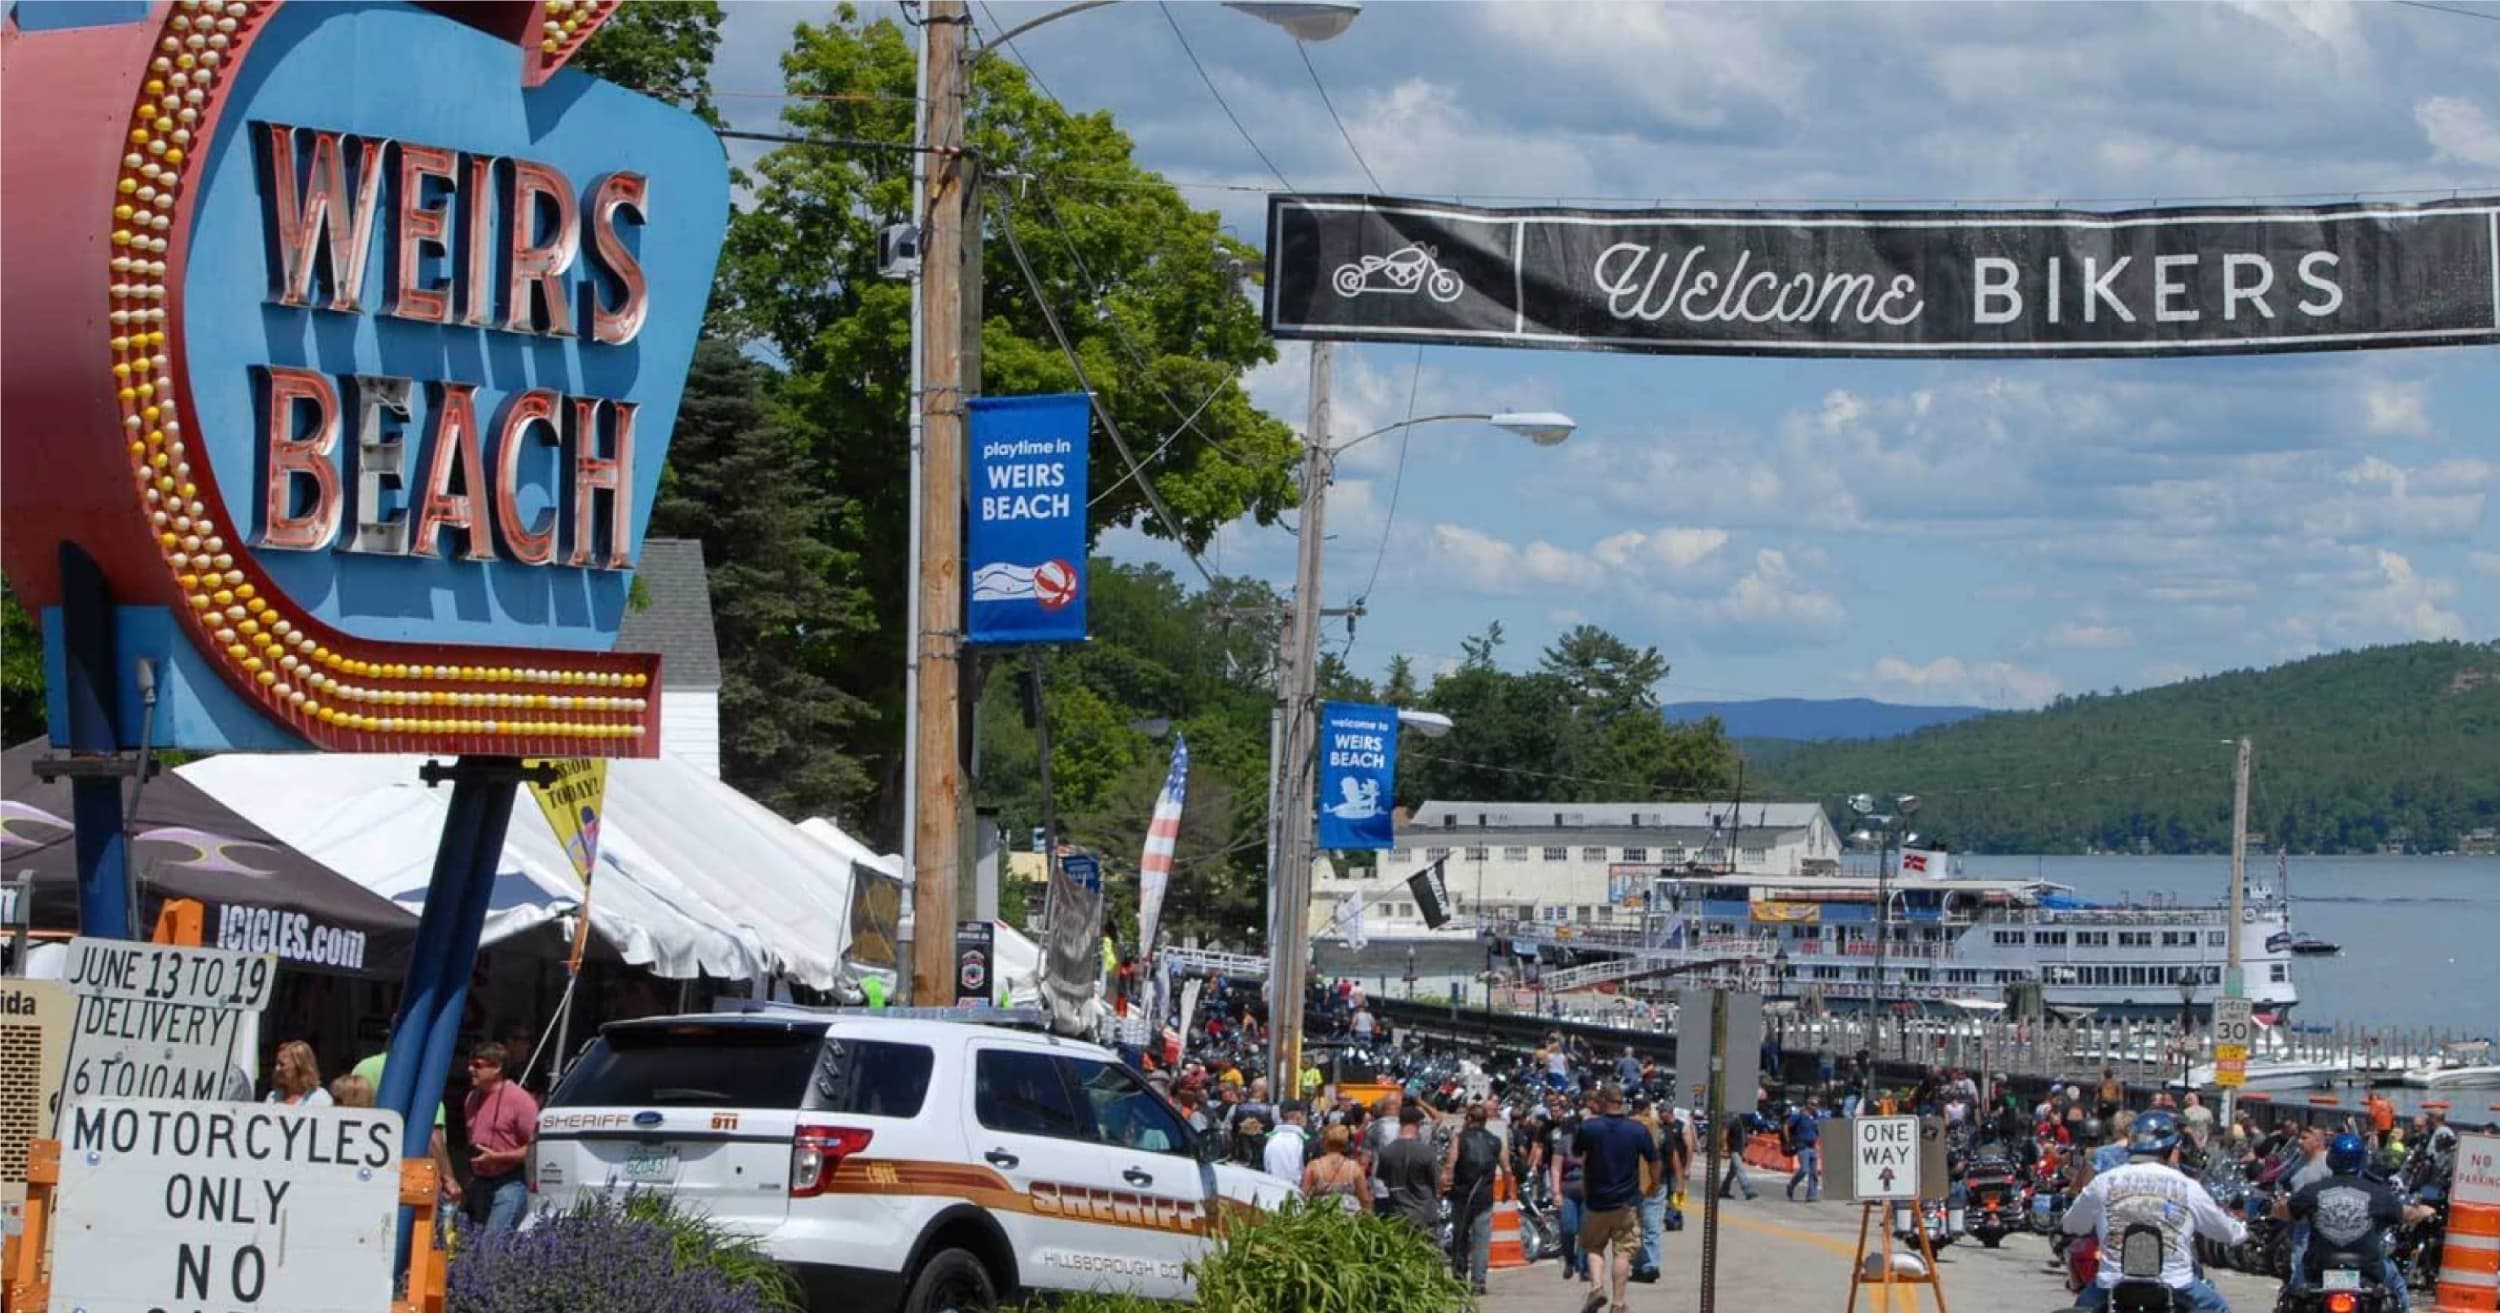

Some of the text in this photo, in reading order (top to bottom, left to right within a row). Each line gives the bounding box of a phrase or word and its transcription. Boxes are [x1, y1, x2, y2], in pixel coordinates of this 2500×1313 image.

[254, 122, 648, 346] WEIRS
[1594, 242, 2343, 325] Welcome BIKERS
[984, 438, 1071, 459] playtime in
[250, 365, 640, 570] BEACH
[987, 463, 1065, 489] WEIRS
[982, 493, 1070, 521] BEACH
[1331, 718, 1388, 731] welcome to
[1335, 734, 1383, 751] WEIRS
[1330, 752, 1385, 769] BEACH
[217, 903, 366, 969] ICICLES.com
[69, 945, 267, 1005] JUNE 13 TO 19
[84, 996, 229, 1046] DELIVERY
[2217, 1022, 2248, 1040] 30
[73, 1058, 91, 1095] 6
[543, 1114, 631, 1129] SHERIFF
[712, 1117, 738, 1130] 911
[1863, 1123, 1909, 1142] ONE
[71, 1106, 393, 1168] MOTORCYLES
[1862, 1146, 1911, 1165] WAY
[2471, 1155, 2493, 1169] NO
[165, 1173, 291, 1225] ONLY
[1029, 1180, 1206, 1234] SHERIFF
[174, 1242, 266, 1303] NO
[1044, 1254, 1155, 1276] HILLSBOROUGH
